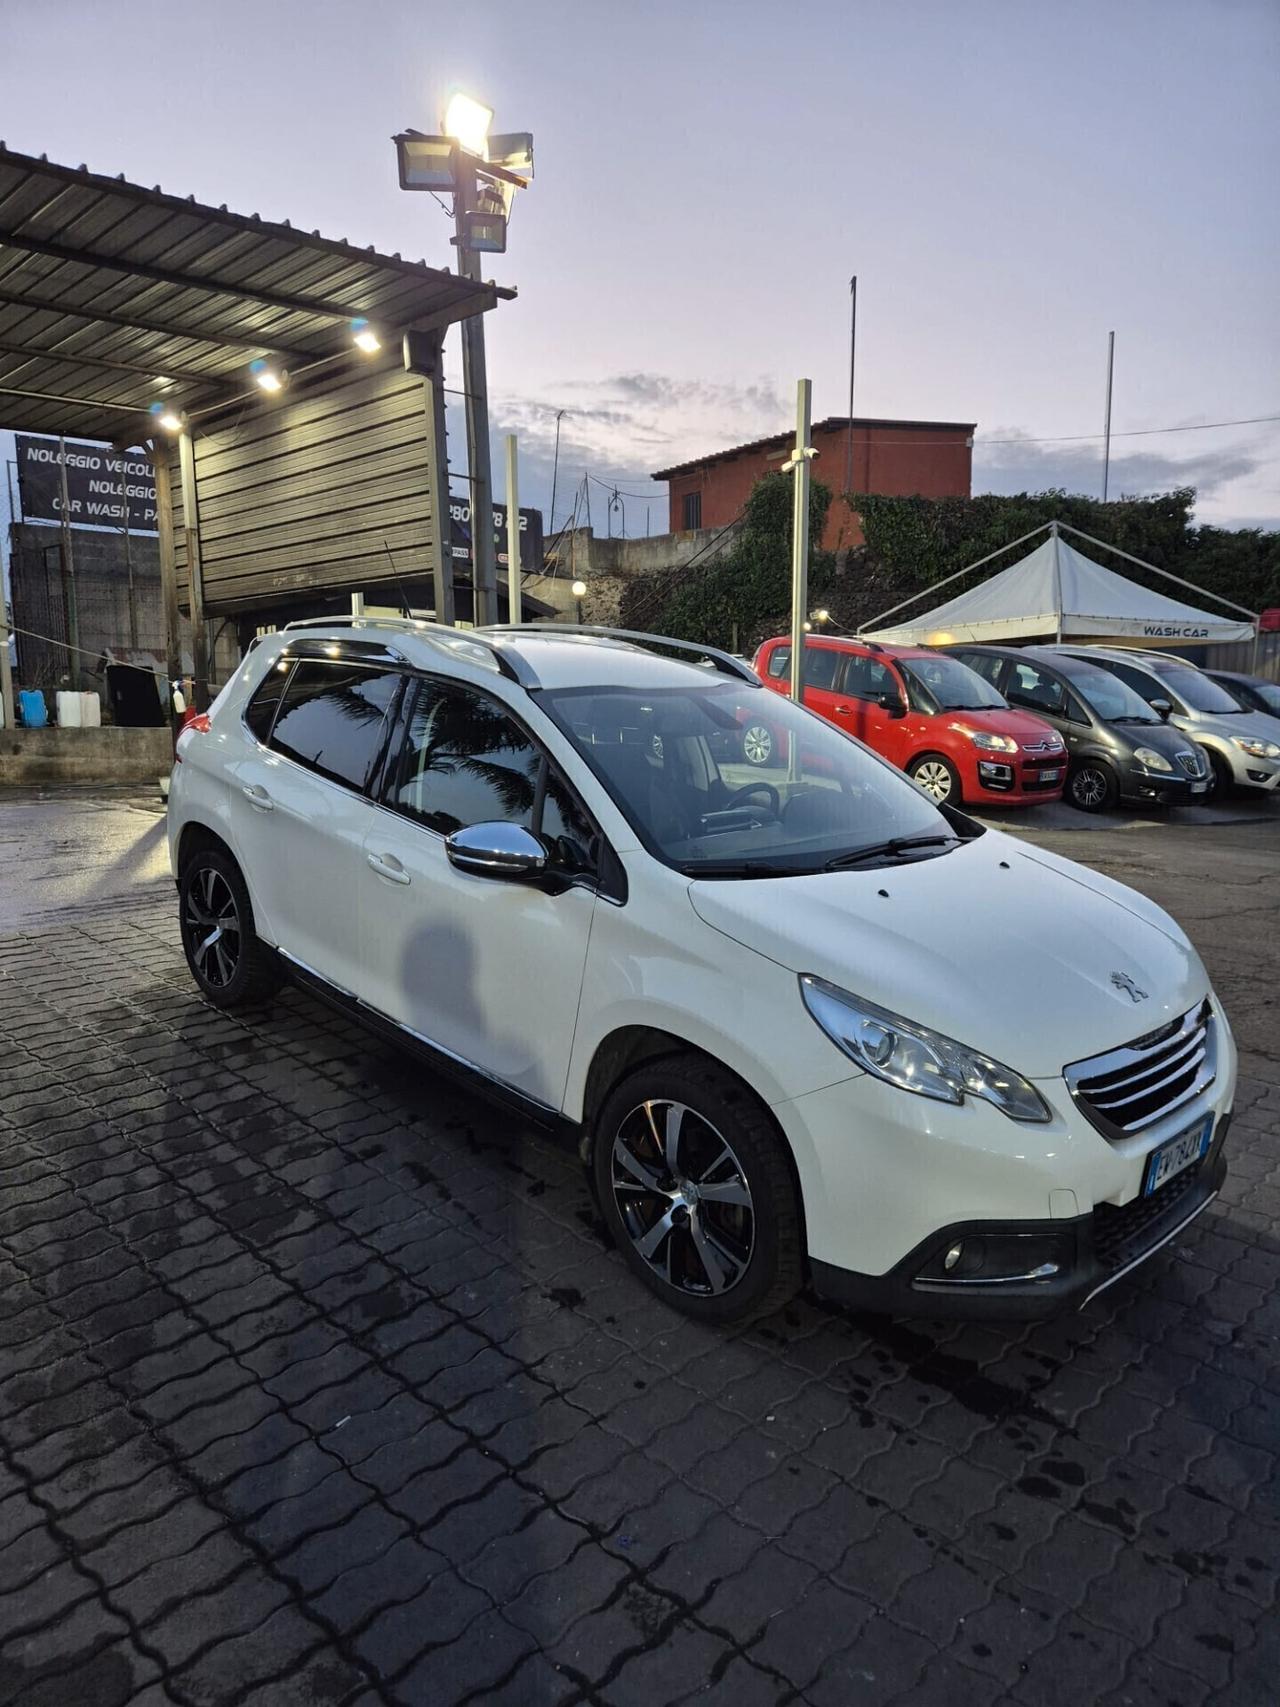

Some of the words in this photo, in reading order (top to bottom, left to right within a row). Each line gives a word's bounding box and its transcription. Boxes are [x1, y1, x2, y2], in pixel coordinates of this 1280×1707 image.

[27, 447, 101, 470] NOLEGGIO
[52, 498, 81, 513] CAR
[87, 502, 130, 519] WASH
[1144, 626, 1180, 637] WASH
[1183, 628, 1209, 638] CAR
